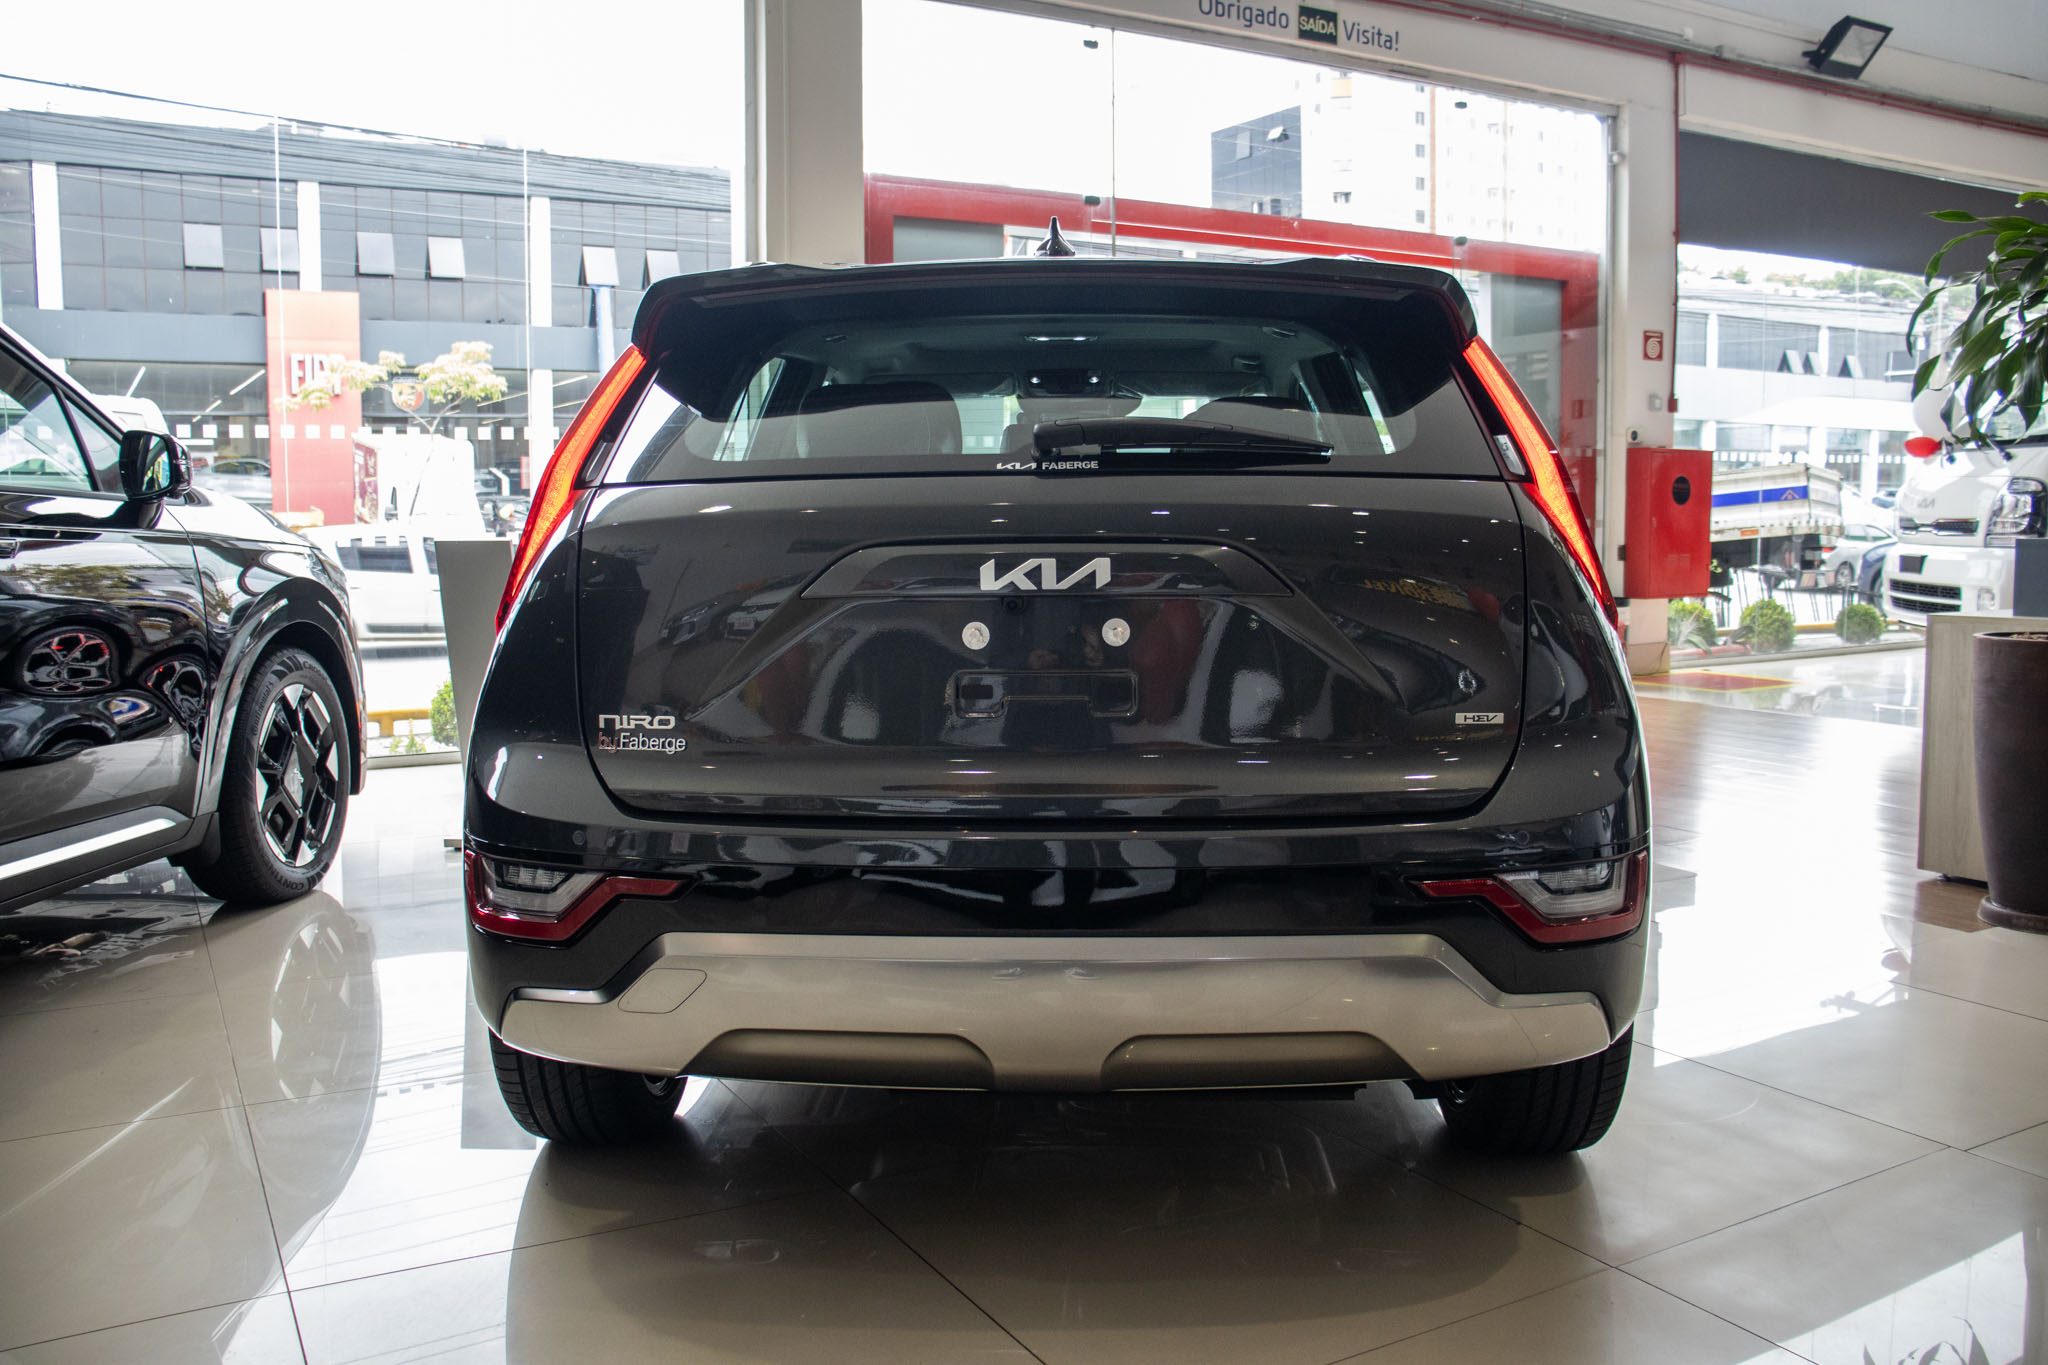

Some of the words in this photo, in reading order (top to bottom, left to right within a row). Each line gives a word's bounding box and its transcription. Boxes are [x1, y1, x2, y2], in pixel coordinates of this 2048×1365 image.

[1199, 0, 1289, 29] Obrigado
[1343, 20, 1400, 51] Visita!
[1299, 15, 1337, 36] SAÍDA
[996, 462, 1037, 470] KIA
[1041, 460, 1099, 470] FABERGE
[980, 557, 1111, 590] KIA
[599, 714, 676, 730] NIRO
[1464, 714, 1498, 722] HEV
[598, 731, 618, 754] by
[620, 732, 687, 755] Faberge
